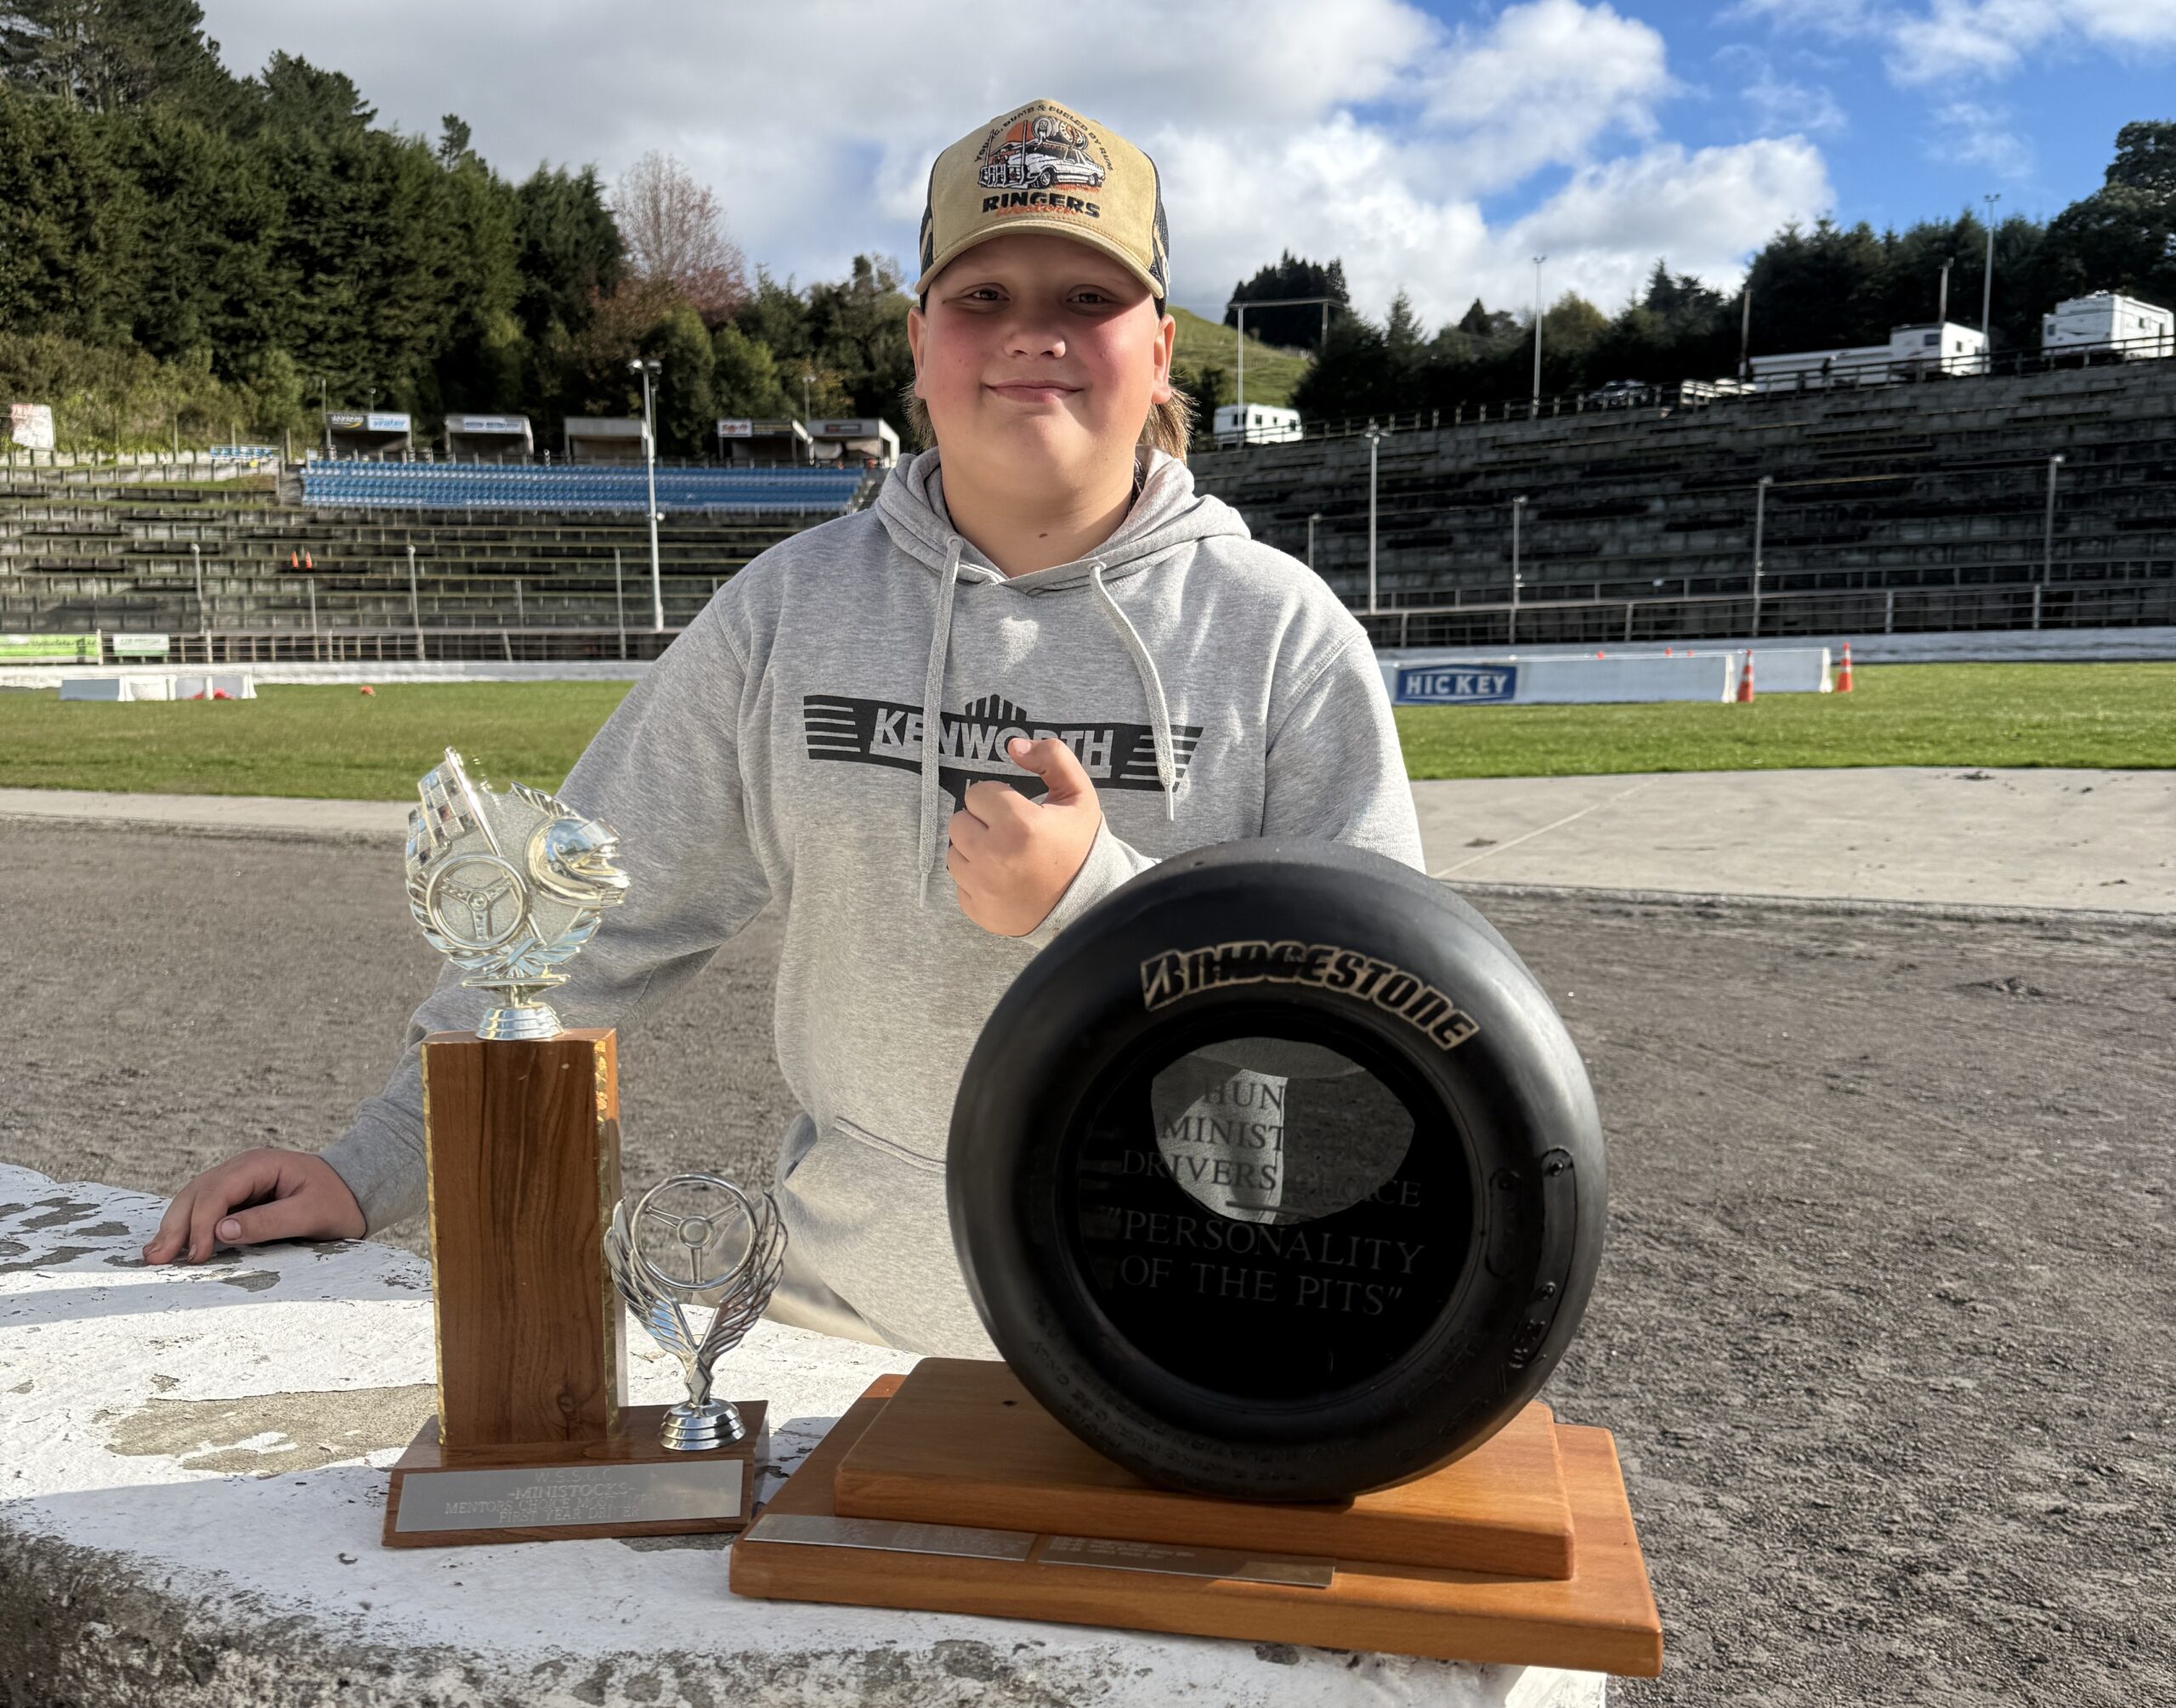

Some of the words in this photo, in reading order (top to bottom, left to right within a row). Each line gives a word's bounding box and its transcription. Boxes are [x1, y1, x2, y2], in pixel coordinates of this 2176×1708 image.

[974, 128, 1003, 162] YOUG,
[1004, 106, 1034, 127] DUMB
[1049, 105, 1088, 132] FUELED
[1088, 133, 1102, 145] BY
[983, 191, 1100, 218] RINGERS
[1406, 674, 1509, 695] HICKEY
[1141, 940, 1480, 1050] BRIDGESTONE
[1121, 1150, 1277, 1190] DRIVERS
[1105, 1206, 1425, 1275] "PERSONALITY
[1119, 1254, 1172, 1288] OF
[1191, 1263, 1277, 1302] THE
[1295, 1274, 1403, 1315] PITS"
[445, 1500, 513, 1514] MENTORS
[518, 1497, 570, 1512] CHOICE
[499, 1511, 537, 1524] FIRST
[545, 1508, 582, 1522] YEAR
[588, 1506, 640, 1519] DRIER
